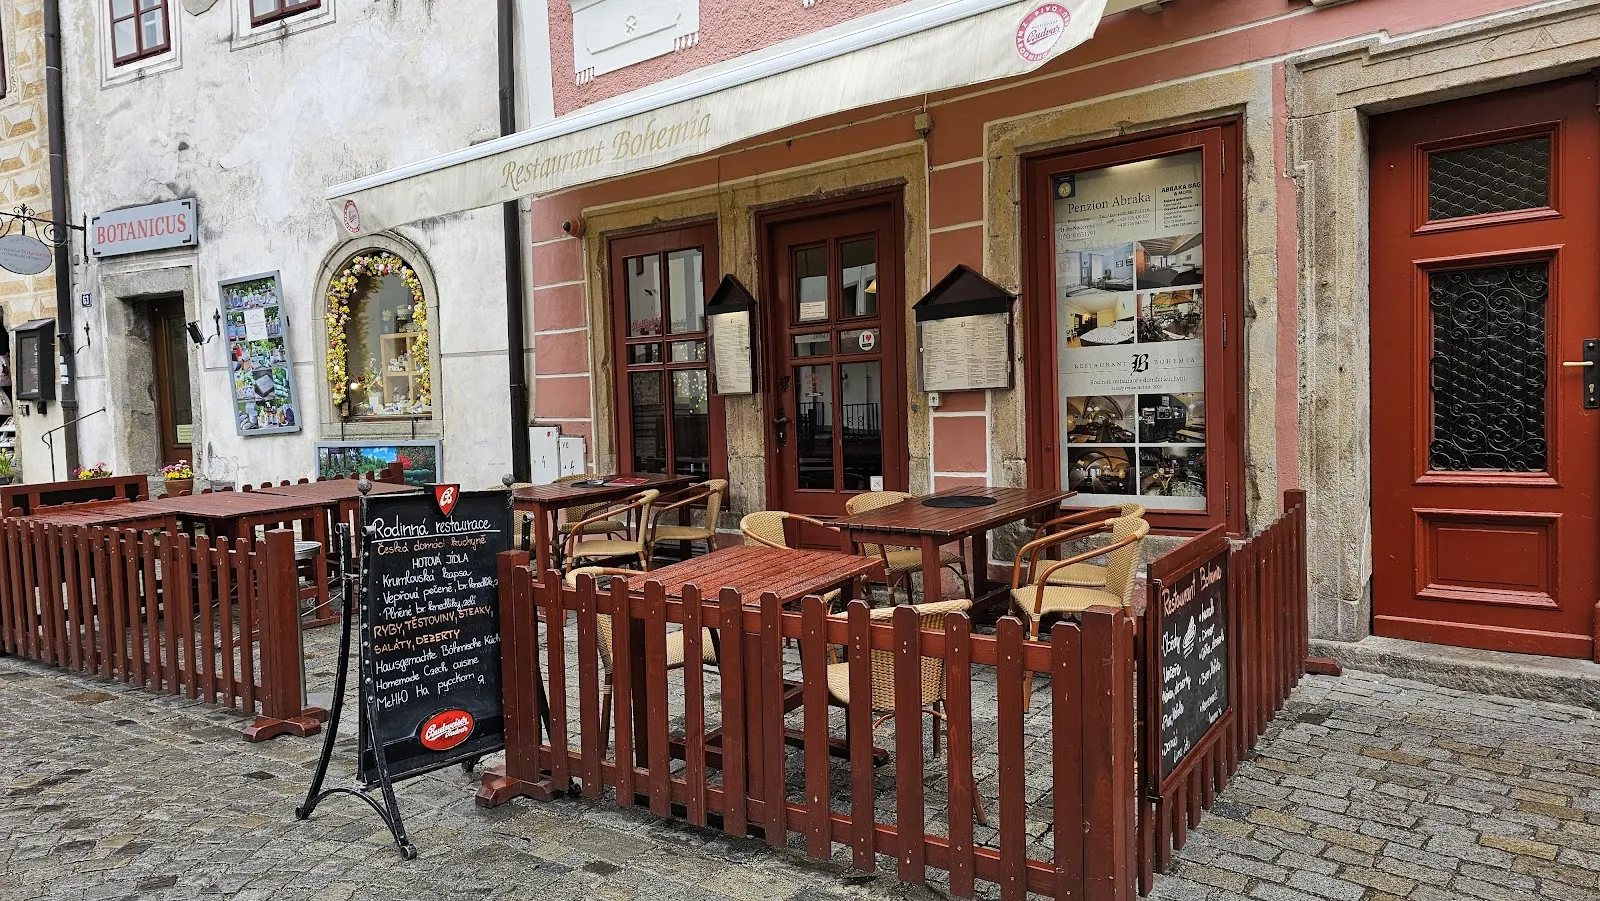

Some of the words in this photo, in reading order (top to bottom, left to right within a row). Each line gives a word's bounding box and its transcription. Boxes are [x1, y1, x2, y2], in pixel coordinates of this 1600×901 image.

[1034, 5, 1058, 17] PIVO
[501, 140, 604, 192] Restaurant
[611, 110, 711, 161] Bohemia
[1161, 184, 1187, 193] ABRAKA
[1068, 200, 1109, 214] Penzion
[1111, 192, 1151, 208] Abraka
[97, 213, 186, 245] BOTANICUS
[1074, 361, 1128, 369] RESTAURANT
[1153, 357, 1195, 365] BOHEMIA
[372, 515, 429, 539] Rodinná
[435, 515, 491, 533] restaurace
[378, 541, 409, 555] Česká
[451, 534, 487, 551] kuchyně
[412, 553, 442, 569] HOTOVÁ
[446, 551, 470, 565] JÍDLA
[382, 569, 435, 588] Krumlovská
[442, 567, 472, 581] kapsa
[383, 586, 419, 607] Vepřová
[1162, 572, 1196, 617] Restaurant
[383, 605, 412, 620] Plněné
[373, 623, 406, 639] RYBY,
[415, 629, 461, 645] DEZERTY
[440, 637, 482, 657] Böhmische
[376, 671, 420, 692] Homemade
[424, 661, 449, 676] Czech
[452, 656, 479, 669] cuisine
[425, 716, 469, 741] Budweiser
